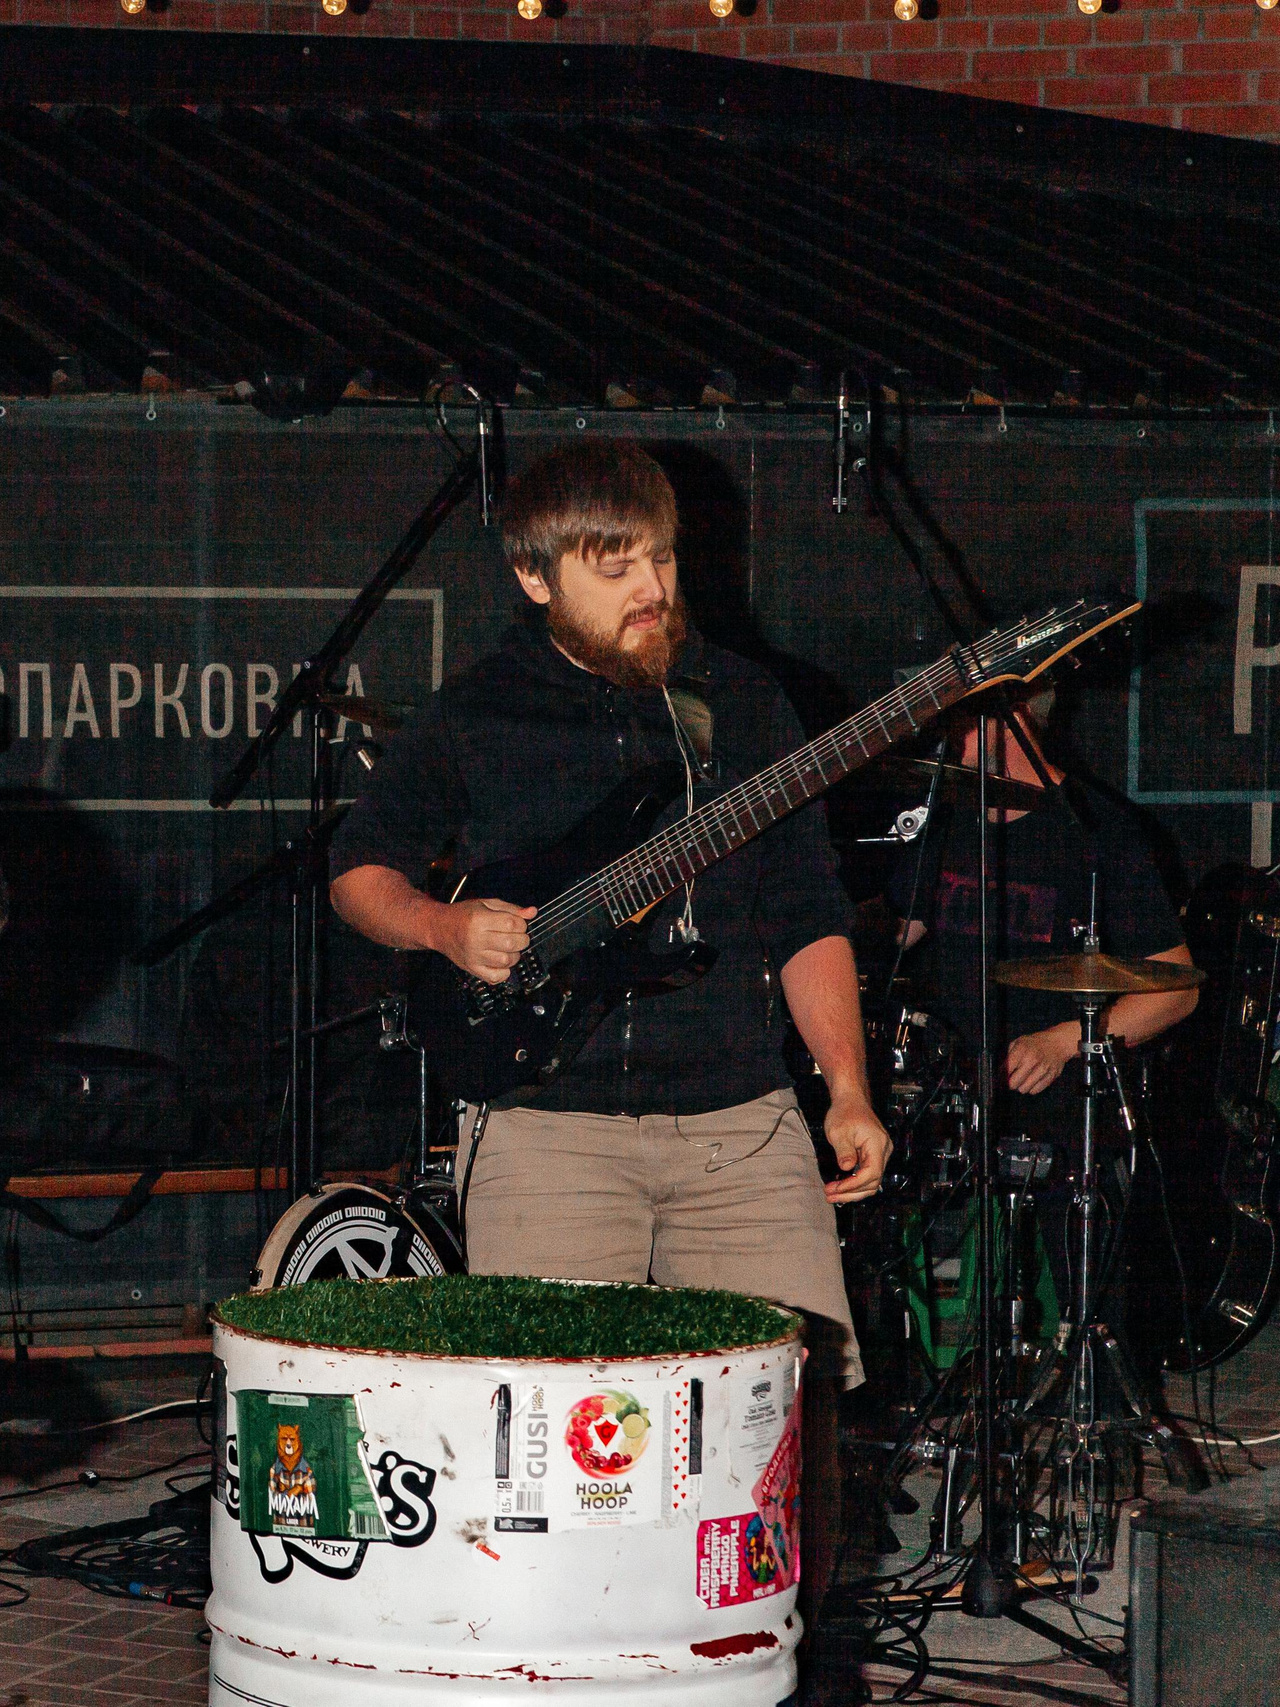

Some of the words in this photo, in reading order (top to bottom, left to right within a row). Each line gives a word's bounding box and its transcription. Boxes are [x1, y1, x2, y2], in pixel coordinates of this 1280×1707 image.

[526, 1413, 549, 1479] GUSI
[268, 1486, 320, 1520] МИХАИЛ
[576, 1482, 633, 1496] HOOLA
[581, 1496, 628, 1510] HOOP
[700, 1557, 710, 1600] CIDER
[710, 1521, 721, 1608] RASPBERRY
[721, 1535, 731, 1586] MANGO
[729, 1519, 741, 1598] PINEAPPLE
